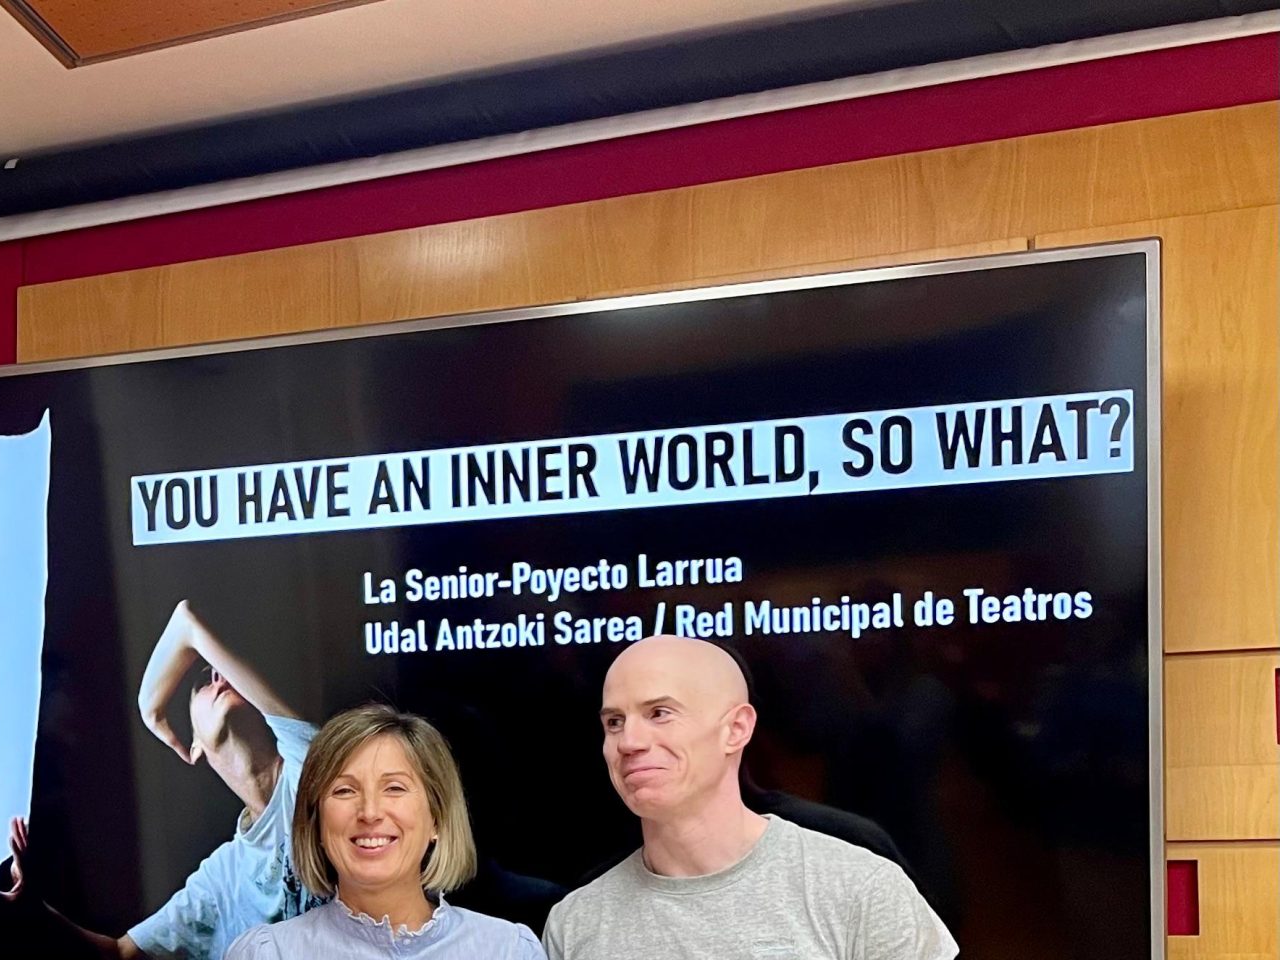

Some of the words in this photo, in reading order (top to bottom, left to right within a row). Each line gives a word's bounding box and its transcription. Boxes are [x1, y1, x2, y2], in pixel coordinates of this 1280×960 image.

[137, 474, 218, 532] YOU
[237, 463, 351, 525] HAVE
[368, 456, 431, 515] AN
[451, 443, 599, 508] INNER
[618, 425, 820, 495] WORLD,
[841, 415, 913, 478] SO
[936, 396, 1132, 470] WHAT?
[363, 571, 396, 605] La
[405, 558, 628, 602] Senior-Poyecto
[638, 553, 743, 589] Larrua
[365, 619, 429, 655] Udal
[435, 612, 545, 651] Antzoki
[553, 611, 643, 645] Sarea
[653, 601, 666, 637] /
[675, 601, 733, 639] Red
[744, 592, 904, 639] Municipal
[913, 590, 955, 627] de
[963, 587, 1093, 624] Teatros
